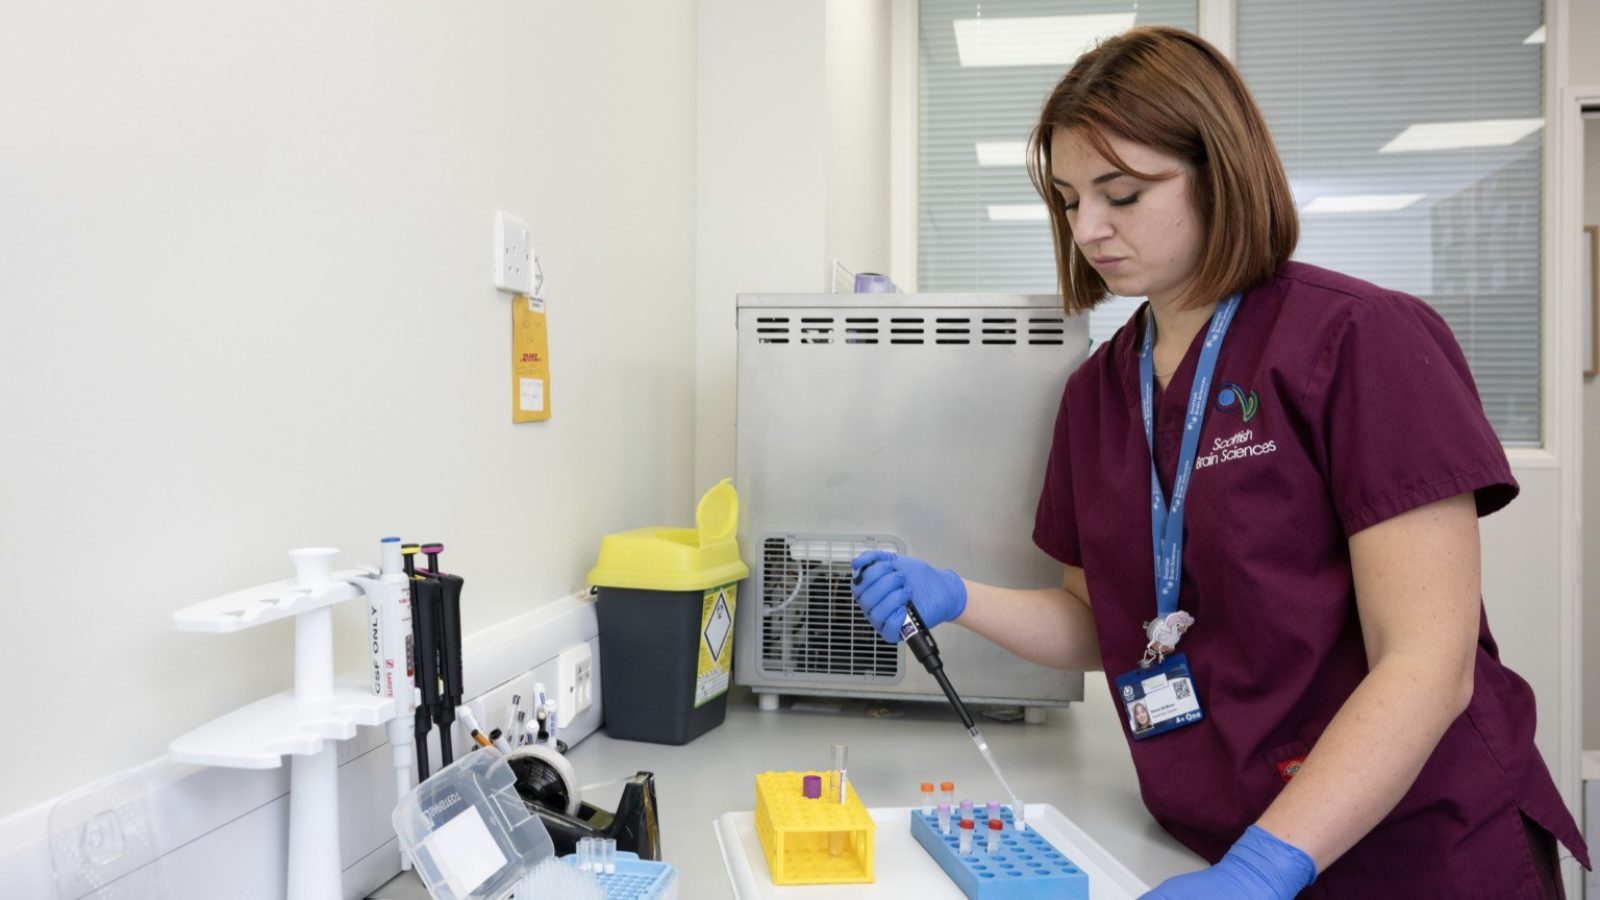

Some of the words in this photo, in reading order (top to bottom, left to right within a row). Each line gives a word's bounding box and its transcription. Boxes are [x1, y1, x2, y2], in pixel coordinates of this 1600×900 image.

[1213, 429, 1253, 451] Scottish
[1220, 440, 1277, 463] Sciences
[371, 606, 379, 654] ONLY
[1176, 716, 1185, 724] As
[1185, 711, 1201, 722] One
